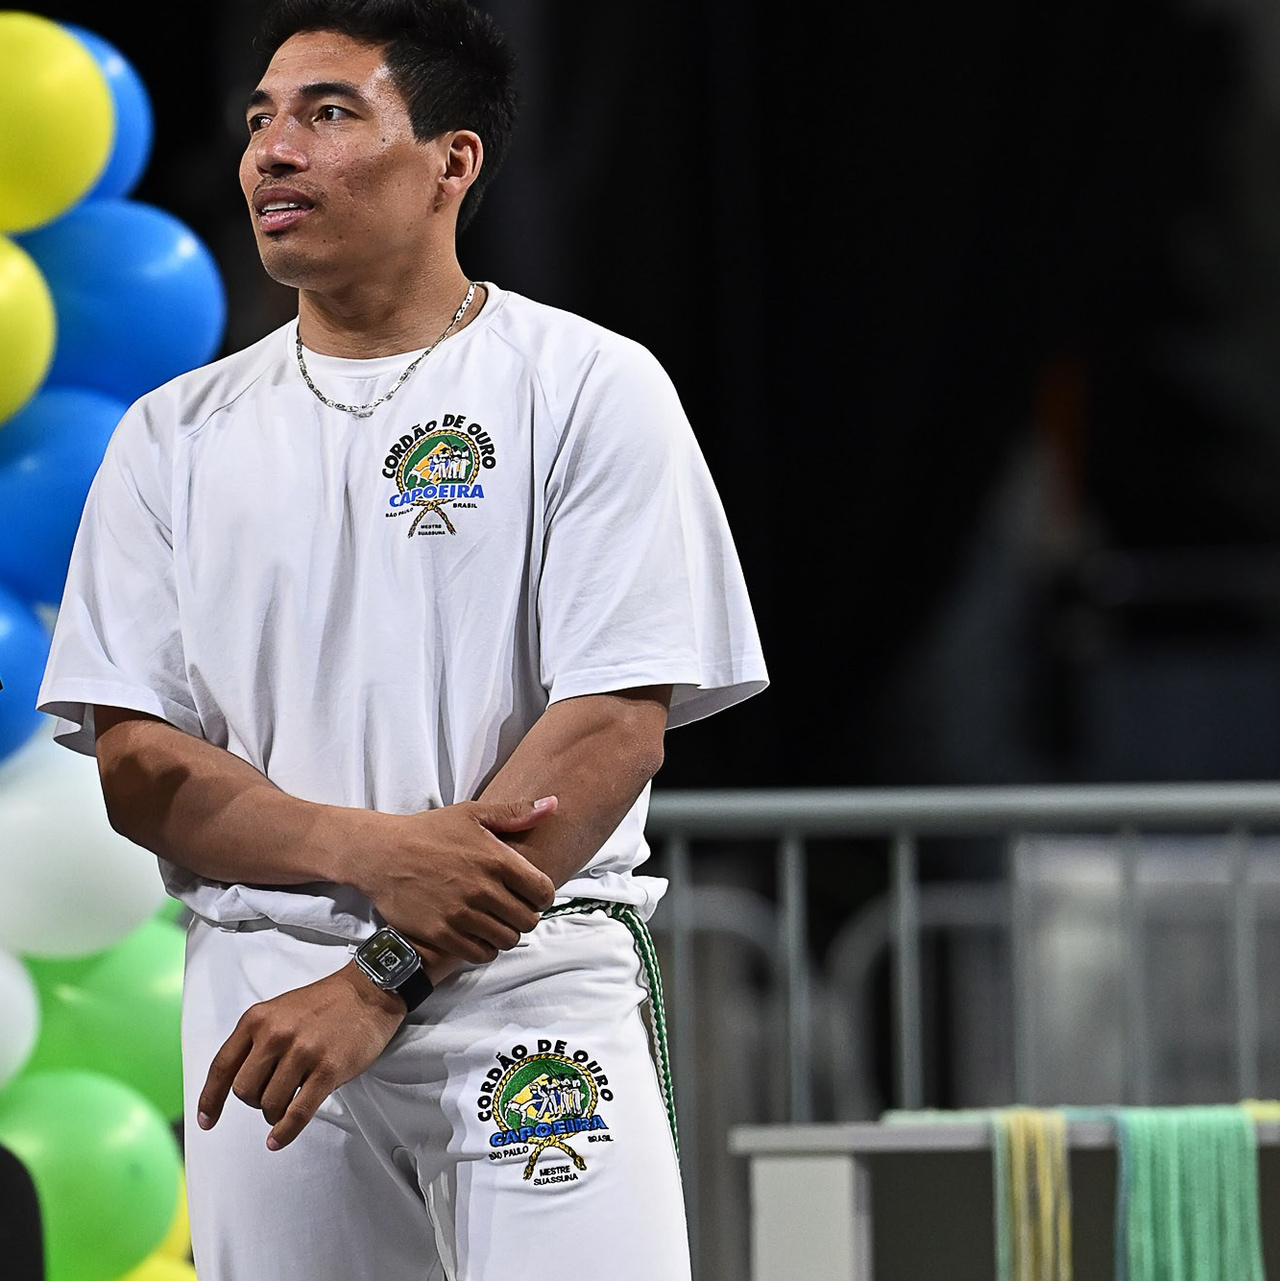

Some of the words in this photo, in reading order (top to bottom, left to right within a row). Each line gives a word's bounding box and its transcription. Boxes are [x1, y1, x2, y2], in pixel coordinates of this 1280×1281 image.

[382, 420, 438, 479] CORDÃO
[442, 414, 467, 429] DE
[467, 423, 497, 469] OURO
[389, 484, 485, 508] CAPOEIRA
[477, 1045, 528, 1122] CORDÃO
[537, 1039, 567, 1055] DE
[573, 1049, 614, 1102] OURO
[489, 1115, 609, 1148] CAPOEIRA
[503, 1145, 529, 1158] PAULO
[533, 1173, 578, 1186] SUASSUNA
[539, 1165, 571, 1177] MESTRE
